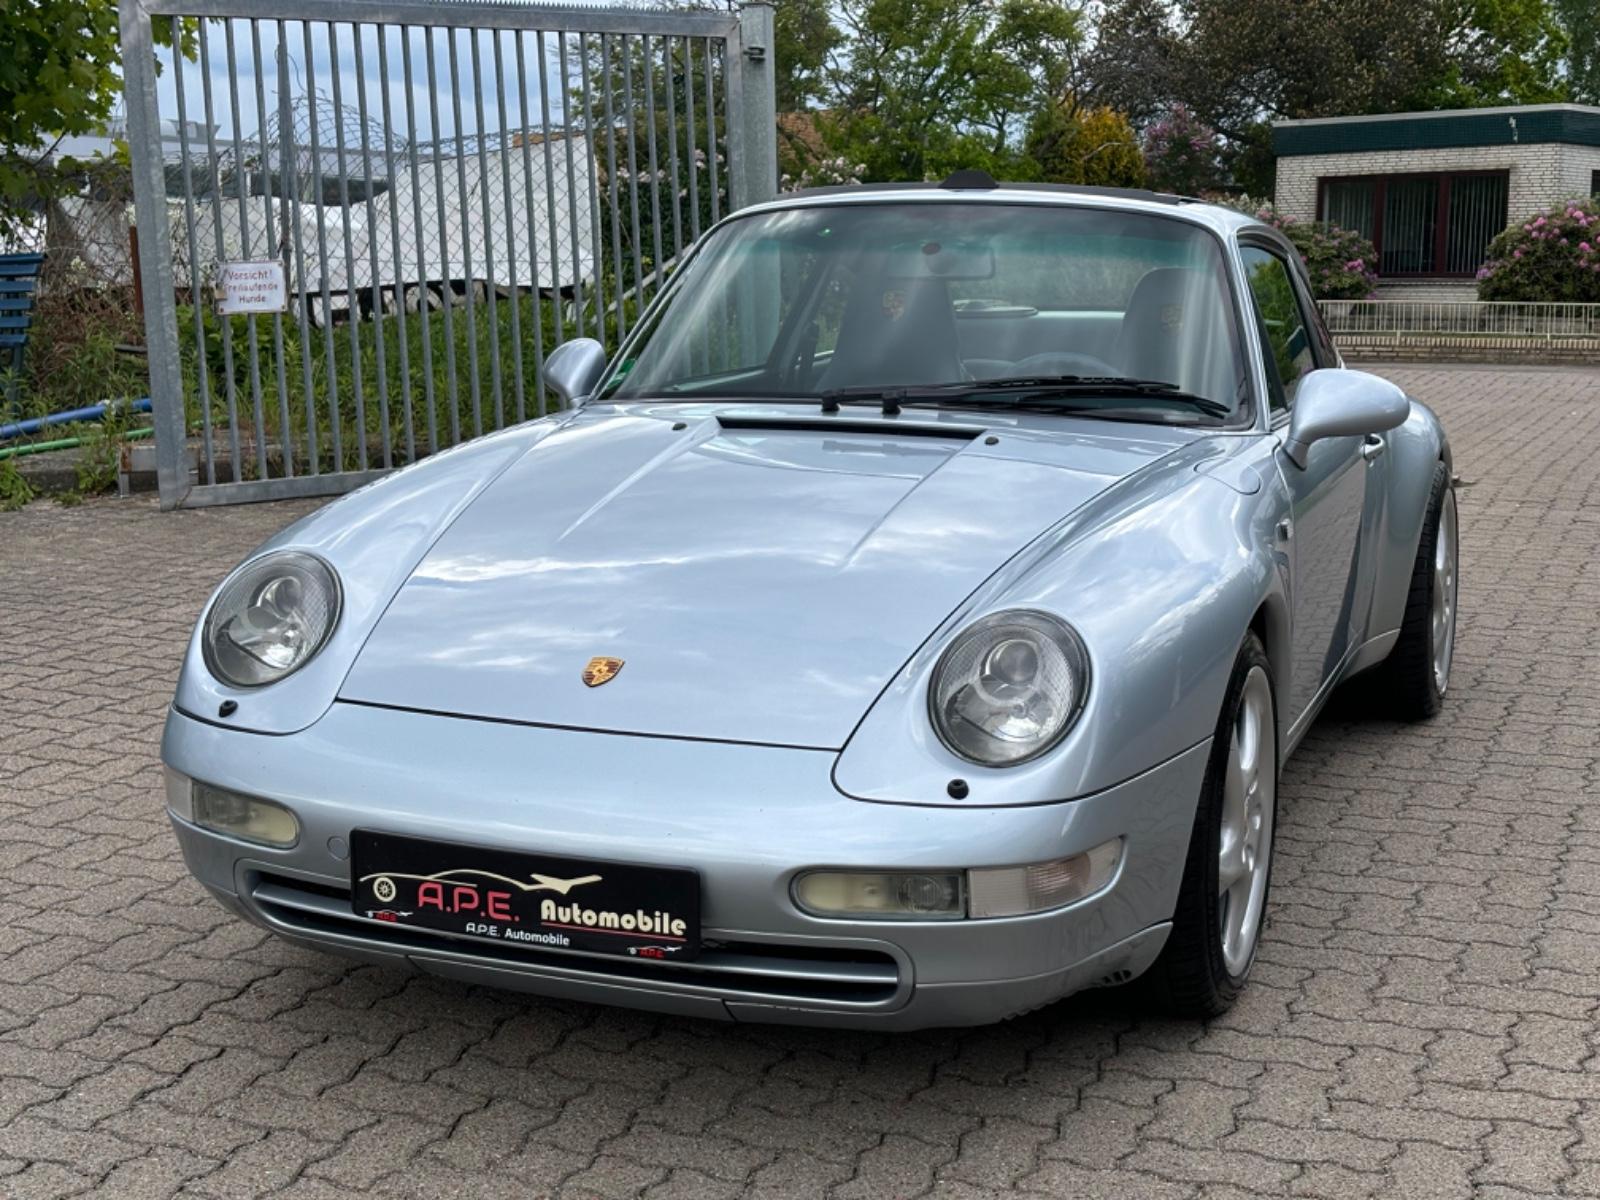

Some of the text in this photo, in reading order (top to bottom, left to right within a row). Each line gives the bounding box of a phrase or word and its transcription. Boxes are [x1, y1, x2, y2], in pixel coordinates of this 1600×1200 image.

[228, 269, 272, 280] Vorsicht!
[239, 294, 266, 303] Hunde
[418, 881, 520, 922] A.P.E.
[541, 899, 687, 936] Automobile
[504, 928, 570, 946] Automobile
